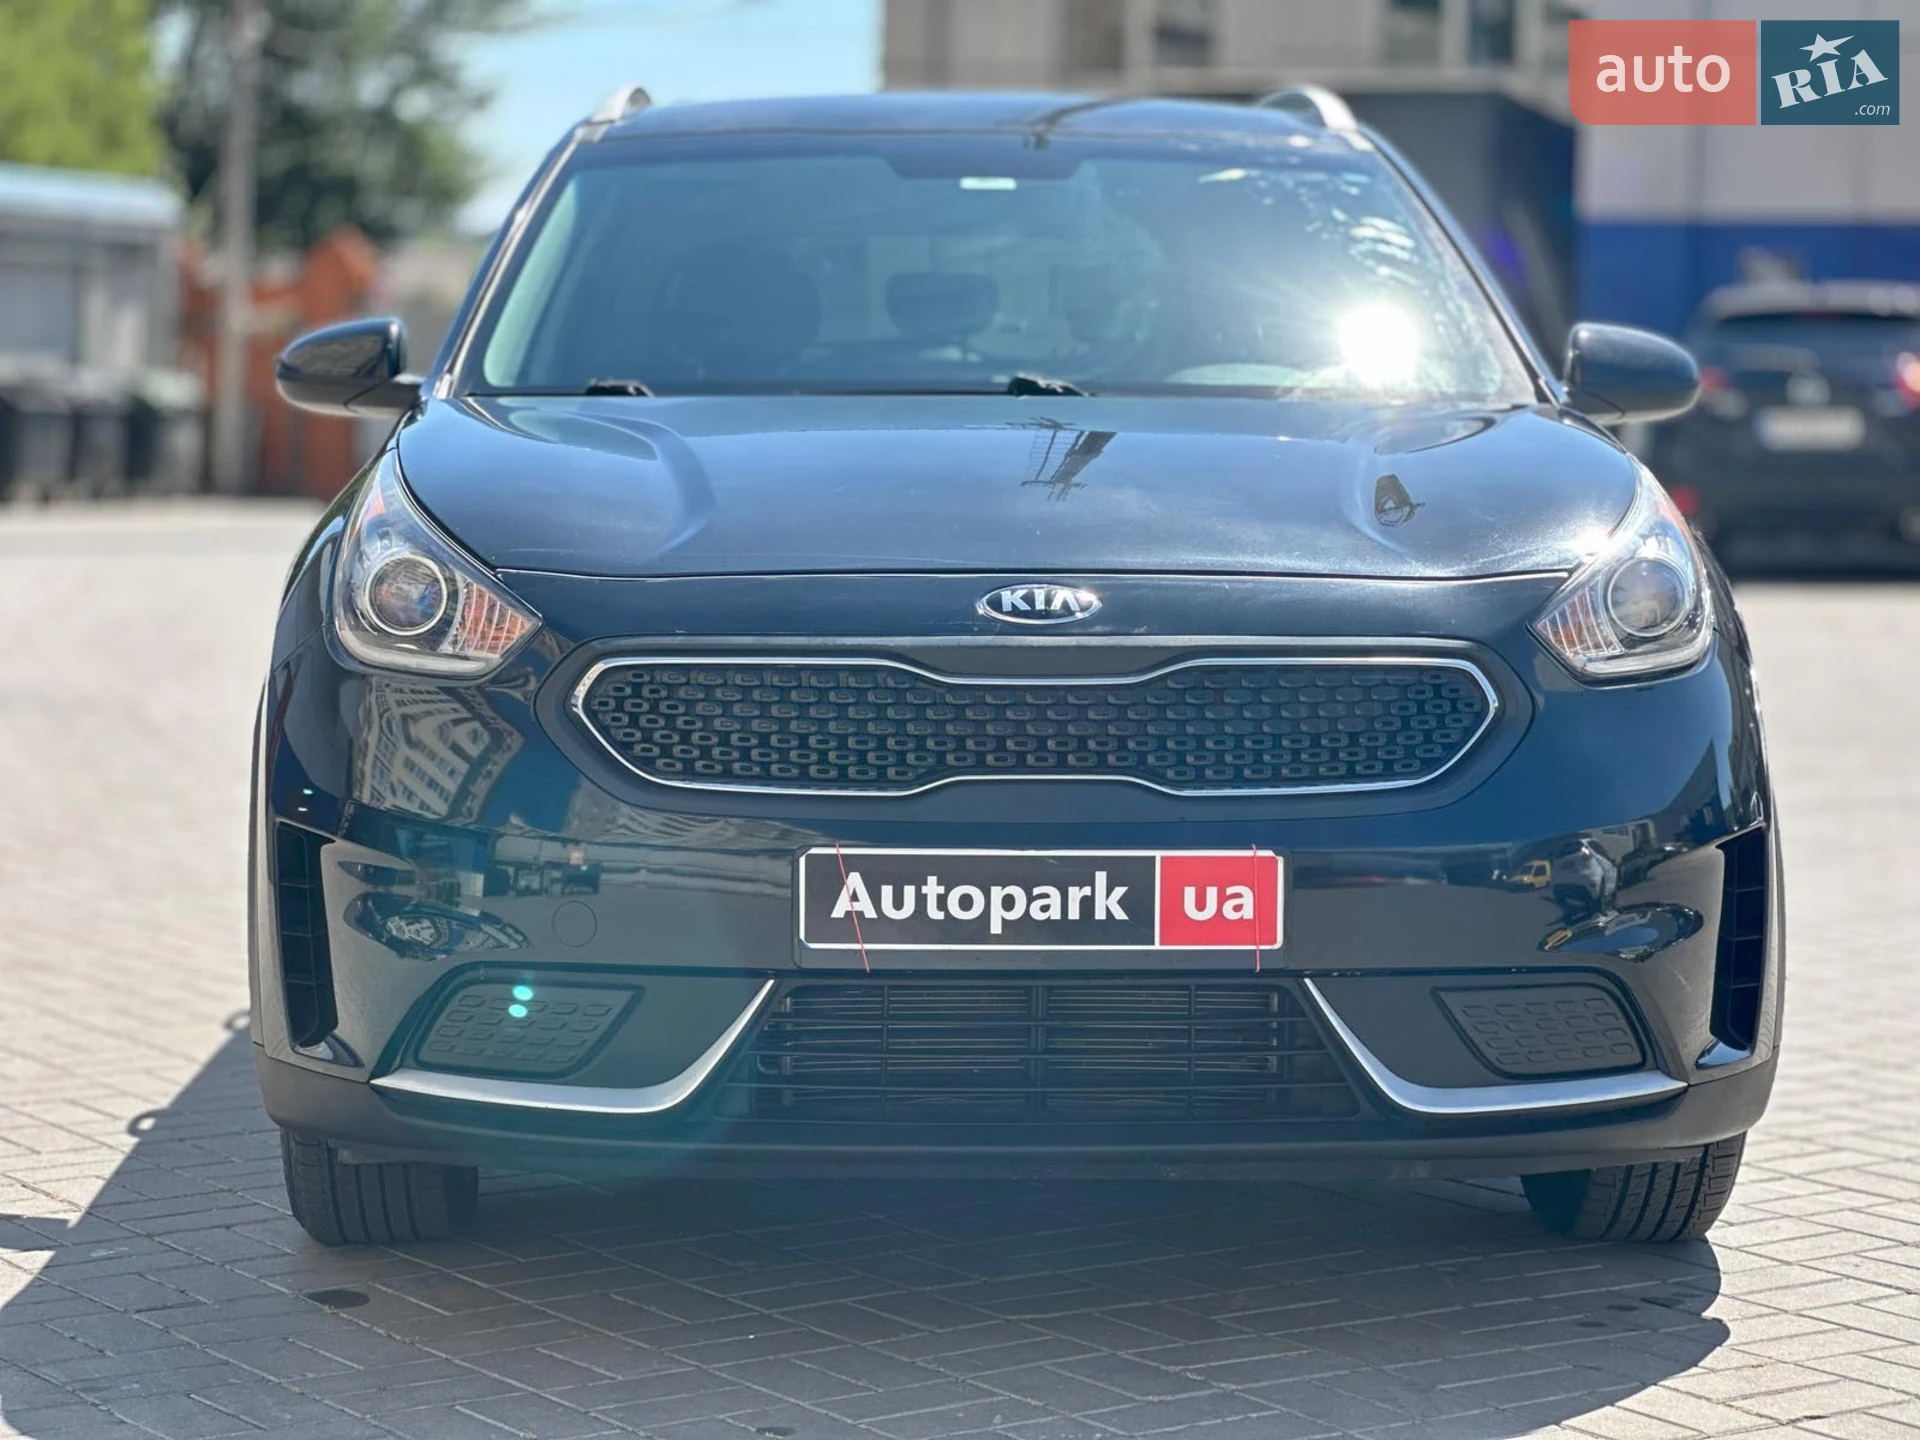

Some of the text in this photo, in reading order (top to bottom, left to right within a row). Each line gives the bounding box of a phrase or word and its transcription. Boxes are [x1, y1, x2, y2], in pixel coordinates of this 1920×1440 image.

[1000, 588, 1080, 612] KIA
[830, 871, 1255, 935] Autopark ua
